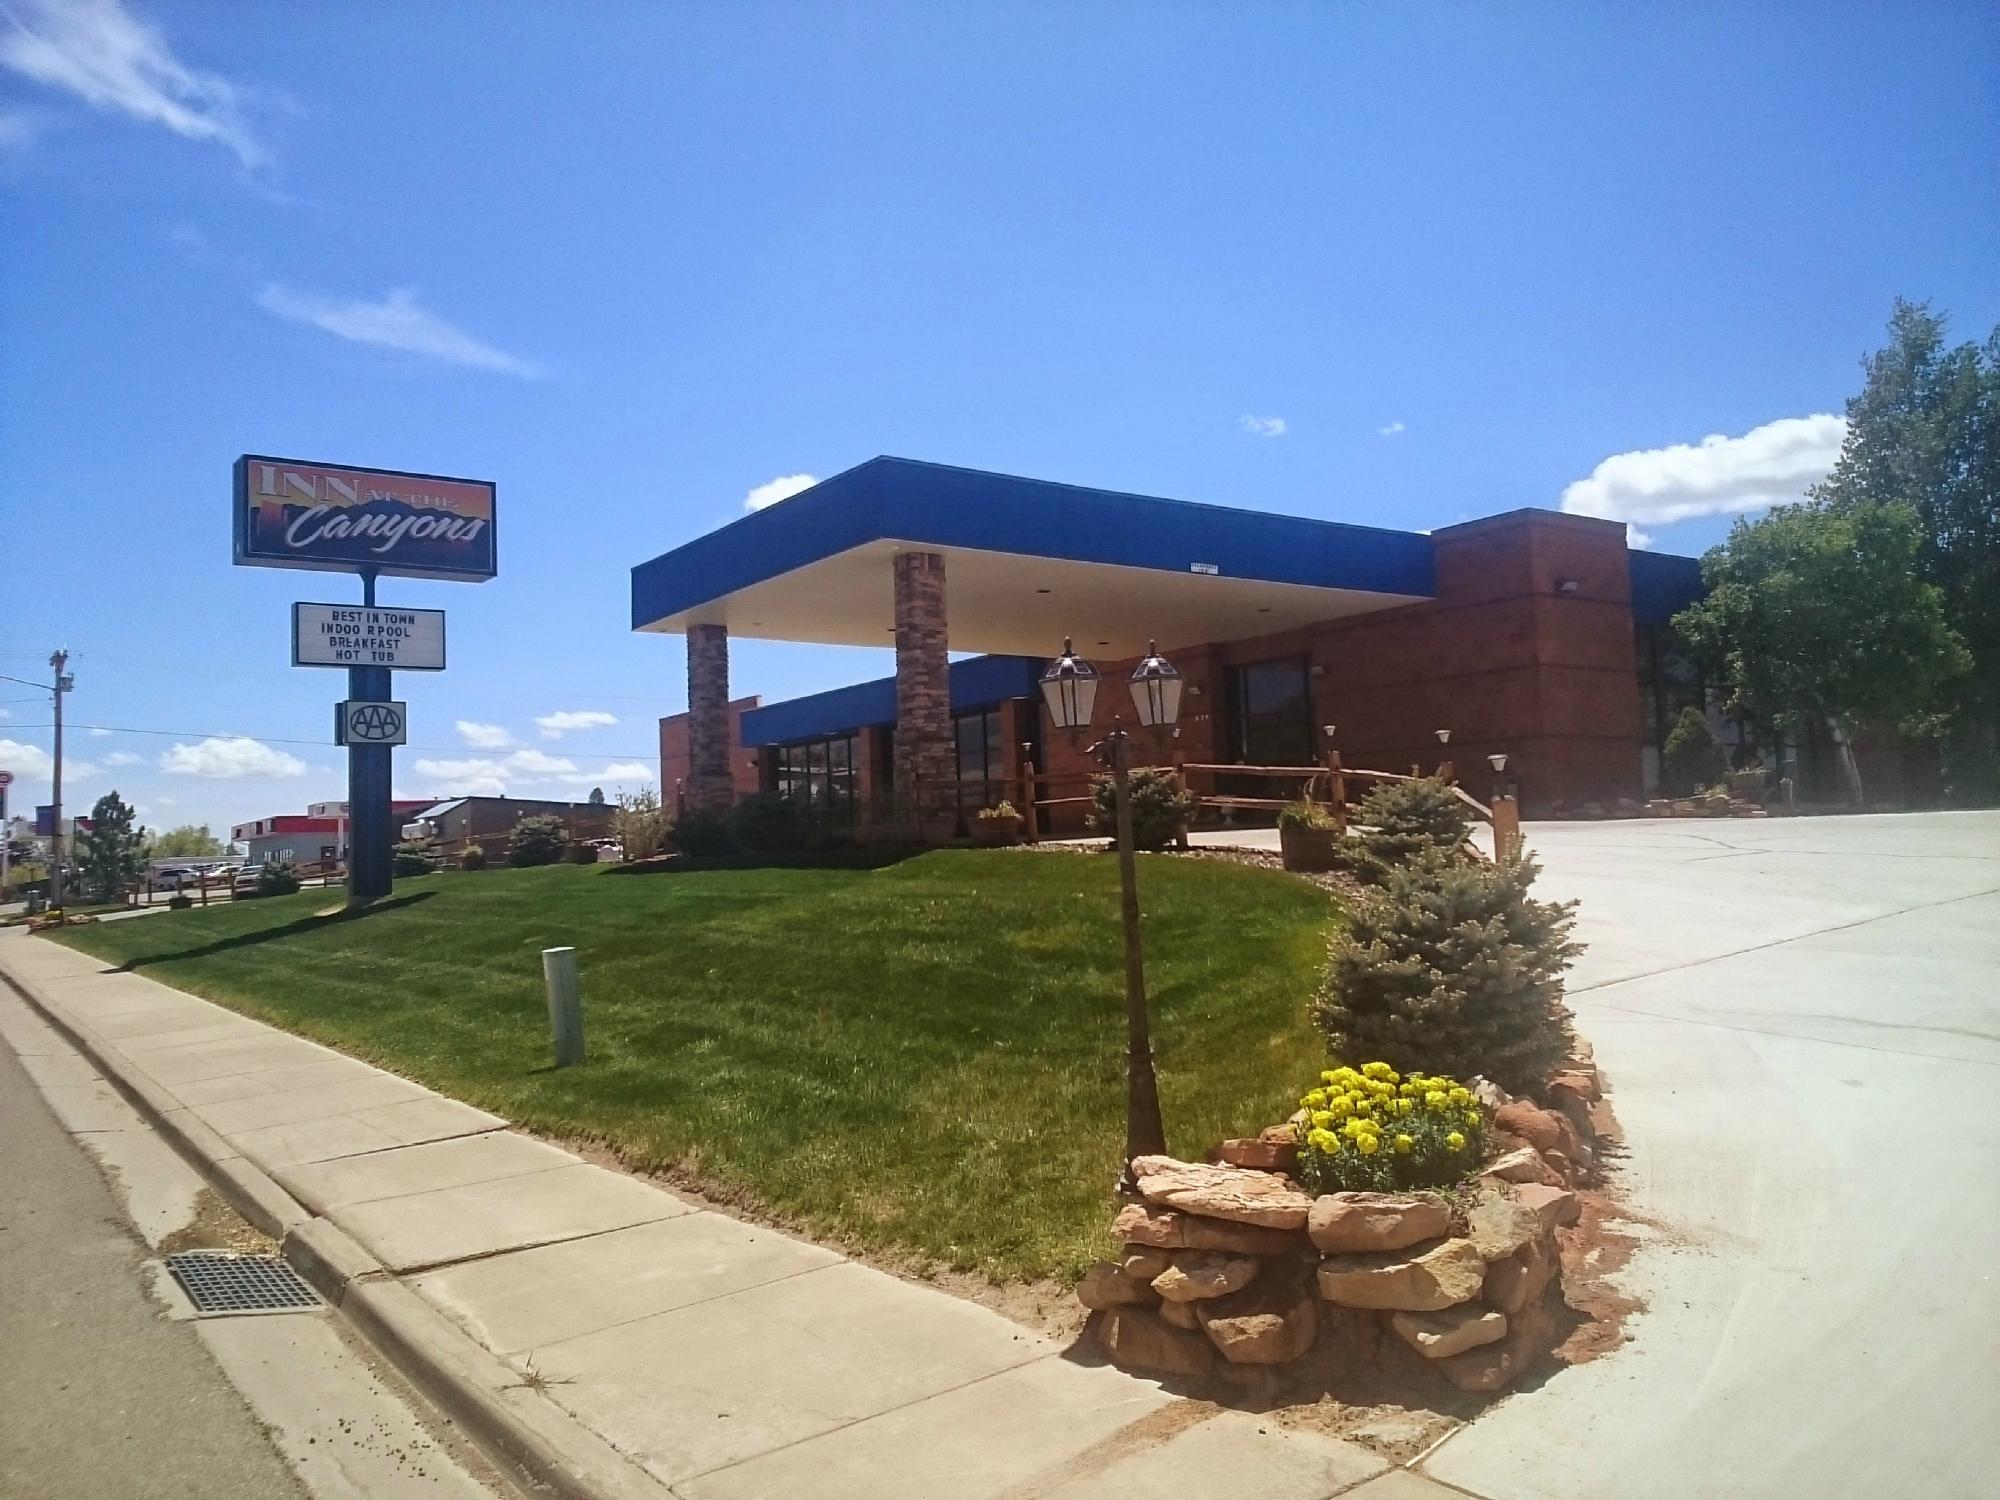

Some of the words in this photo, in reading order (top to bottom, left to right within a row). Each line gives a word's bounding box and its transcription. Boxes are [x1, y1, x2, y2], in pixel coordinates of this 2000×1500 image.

[256, 464, 360, 504] INN
[363, 488, 397, 502] AT
[403, 491, 459, 508] THE
[286, 503, 486, 553] Canyons
[332, 610, 363, 623] BEST
[366, 612, 380, 624] IN
[383, 612, 416, 625] TOWN
[329, 636, 401, 649] BREAKFAST
[335, 650, 361, 660] HOT
[371, 651, 395, 662] TUB
[351, 705, 401, 739] AAA
